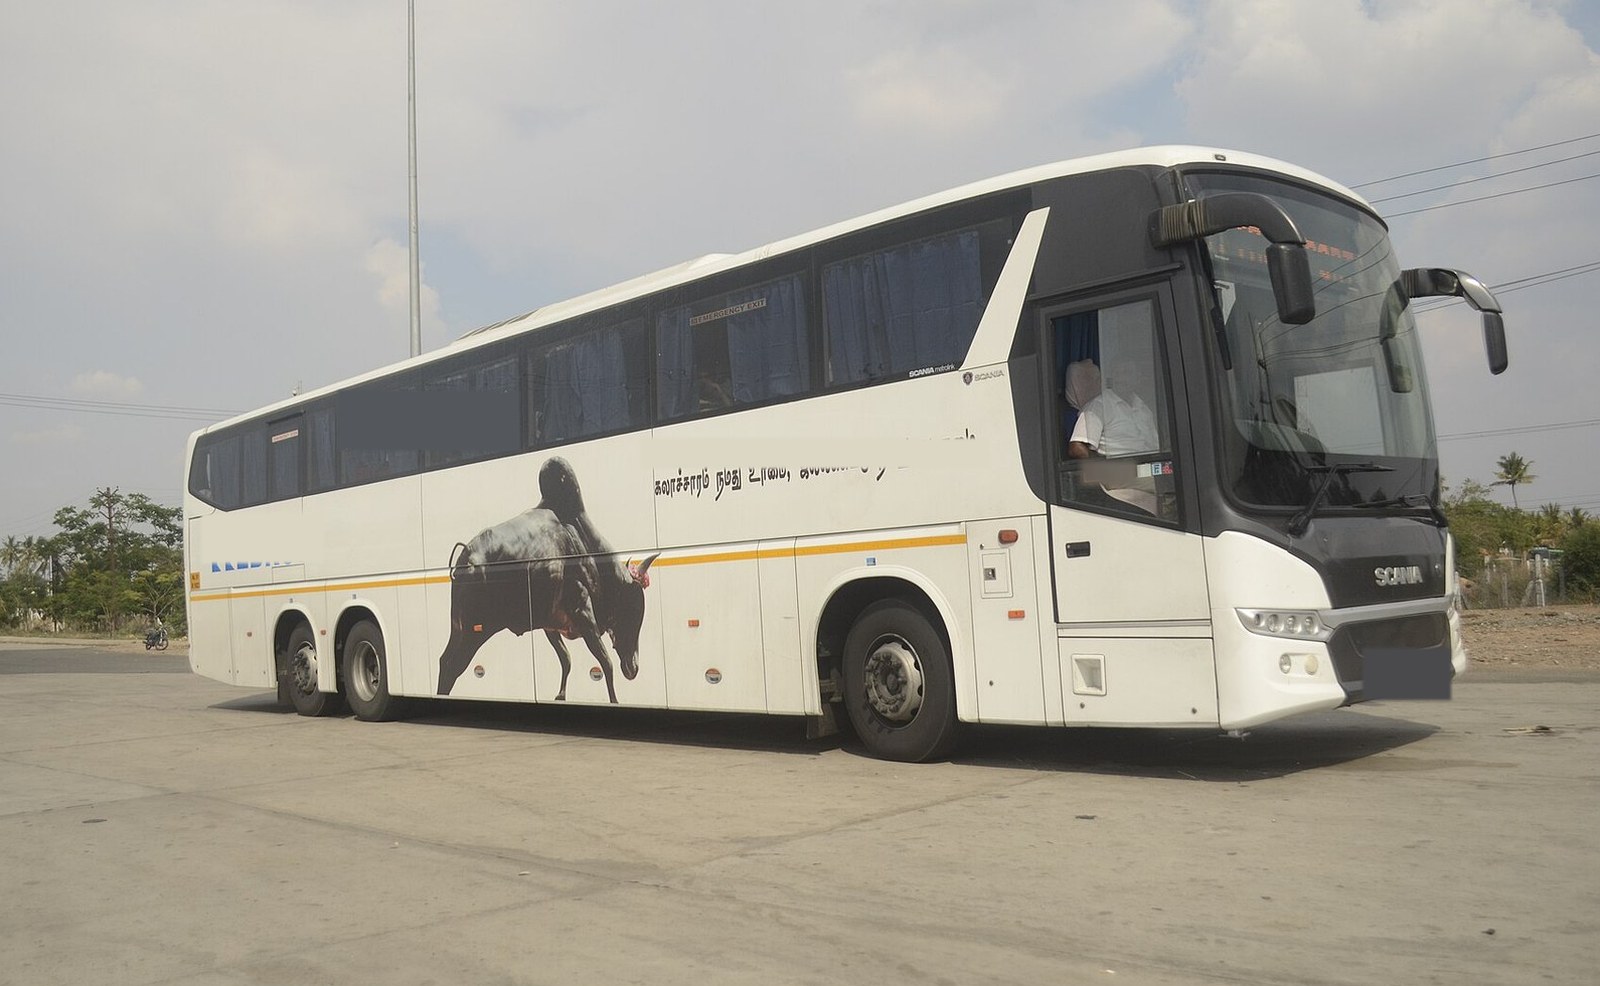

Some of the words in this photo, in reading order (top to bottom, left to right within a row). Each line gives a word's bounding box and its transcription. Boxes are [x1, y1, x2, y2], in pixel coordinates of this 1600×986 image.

[698, 304, 746, 322] EMERGENCY
[747, 300, 765, 310] EXIT
[908, 366, 935, 378] SCANIA
[974, 369, 1005, 382] SCANIA
[1374, 565, 1423, 587] SCANIA
